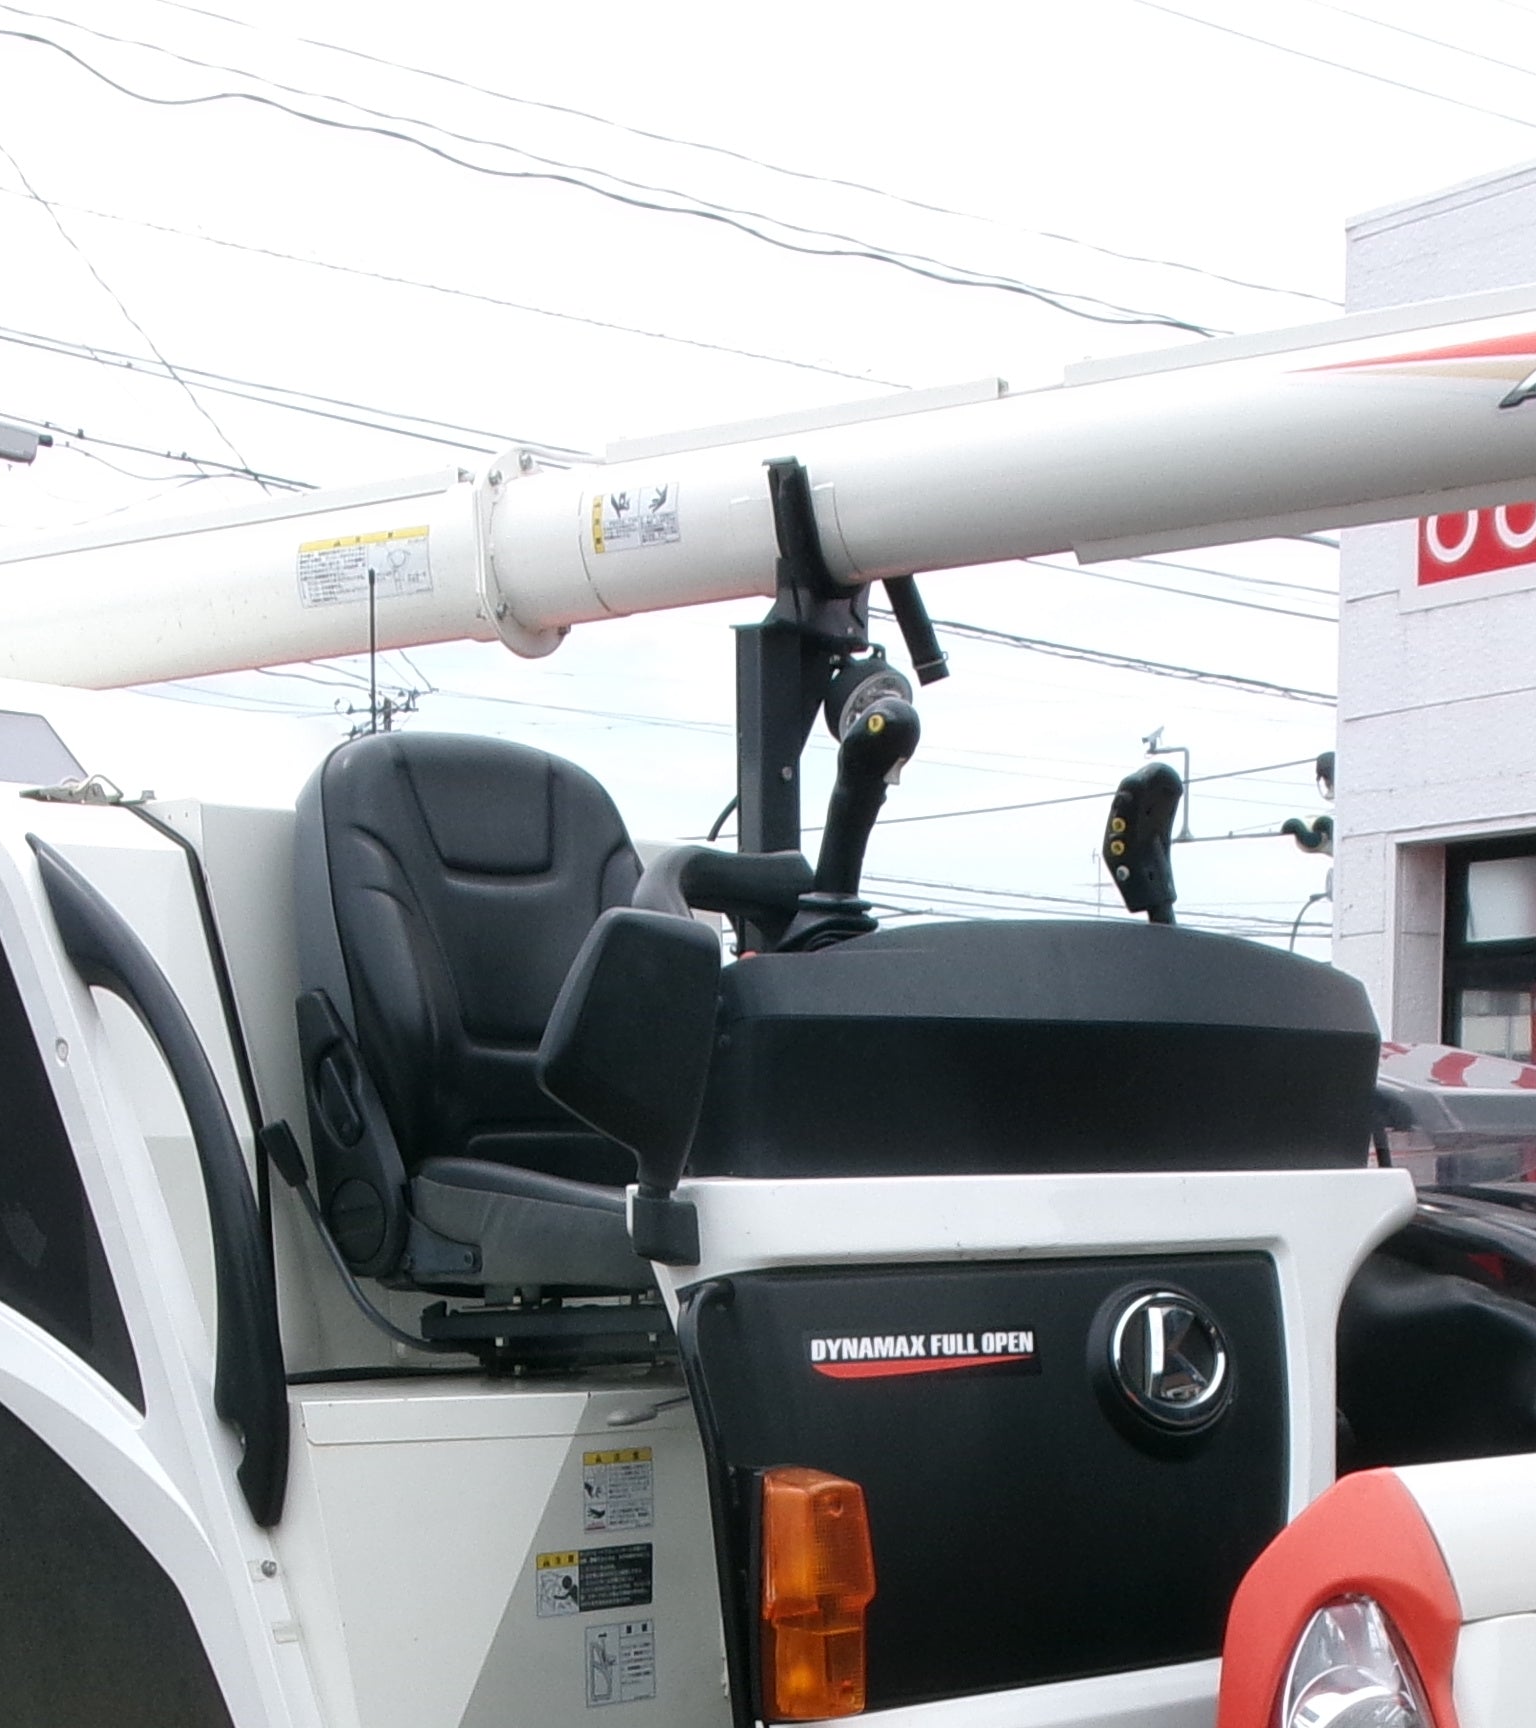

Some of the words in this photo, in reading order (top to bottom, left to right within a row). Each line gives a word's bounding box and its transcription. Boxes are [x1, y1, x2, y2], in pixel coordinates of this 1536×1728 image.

[811, 1334, 926, 1362] DYNAMAX
[930, 1332, 979, 1356] FULL
[981, 1330, 1034, 1354] OPEN
